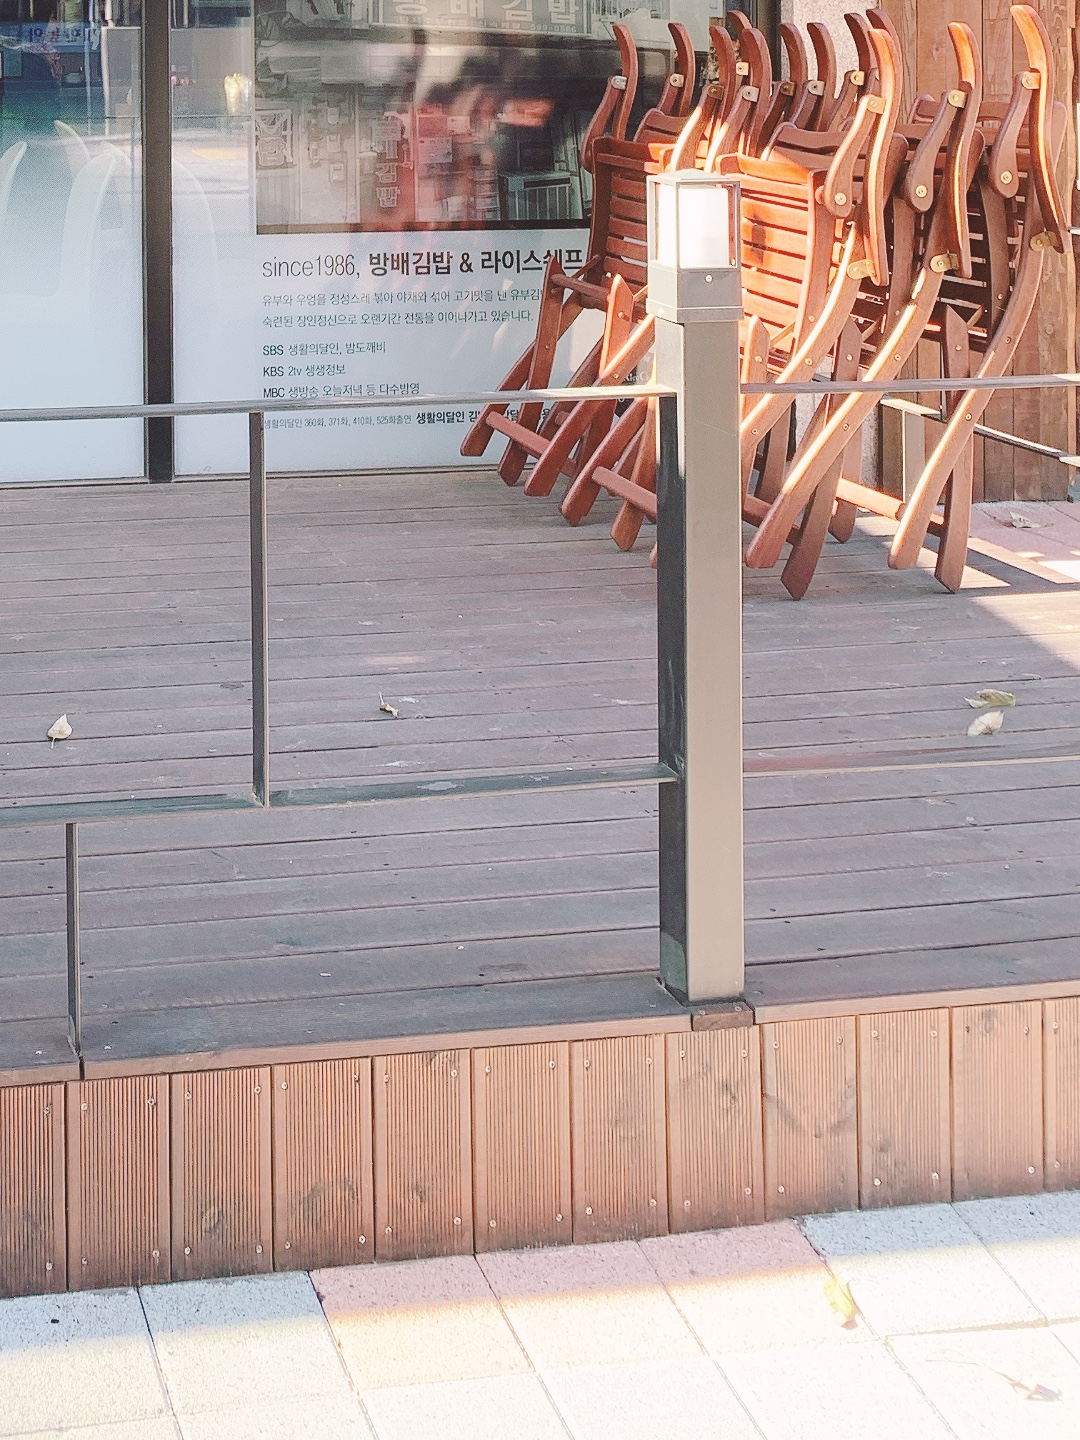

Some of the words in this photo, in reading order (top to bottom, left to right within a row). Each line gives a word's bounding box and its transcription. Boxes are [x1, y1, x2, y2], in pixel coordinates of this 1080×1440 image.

[369, 251, 454, 277] 방배김밥
[460, 252, 474, 273] &
[262, 294, 293, 307] 유부와
[330, 292, 370, 306] 정성스레
[396, 291, 428, 304] 야채와
[510, 288, 543, 301] 유부김
[262, 315, 293, 328] 숙련된
[296, 314, 357, 327] 장인정신으로
[404, 312, 434, 325] 전통을
[437, 311, 488, 324] 이어나가고
[262, 344, 284, 356] SBS
[262, 365, 284, 377] KBS
[288, 365, 302, 377] 2tv
[305, 363, 346, 377] 생생정보
[263, 387, 285, 398] MBC
[288, 385, 319, 399] 생방송
[322, 383, 363, 398] 오늘저녁
[365, 383, 376, 396] 등
[416, 409, 465, 425] 생활의달인
